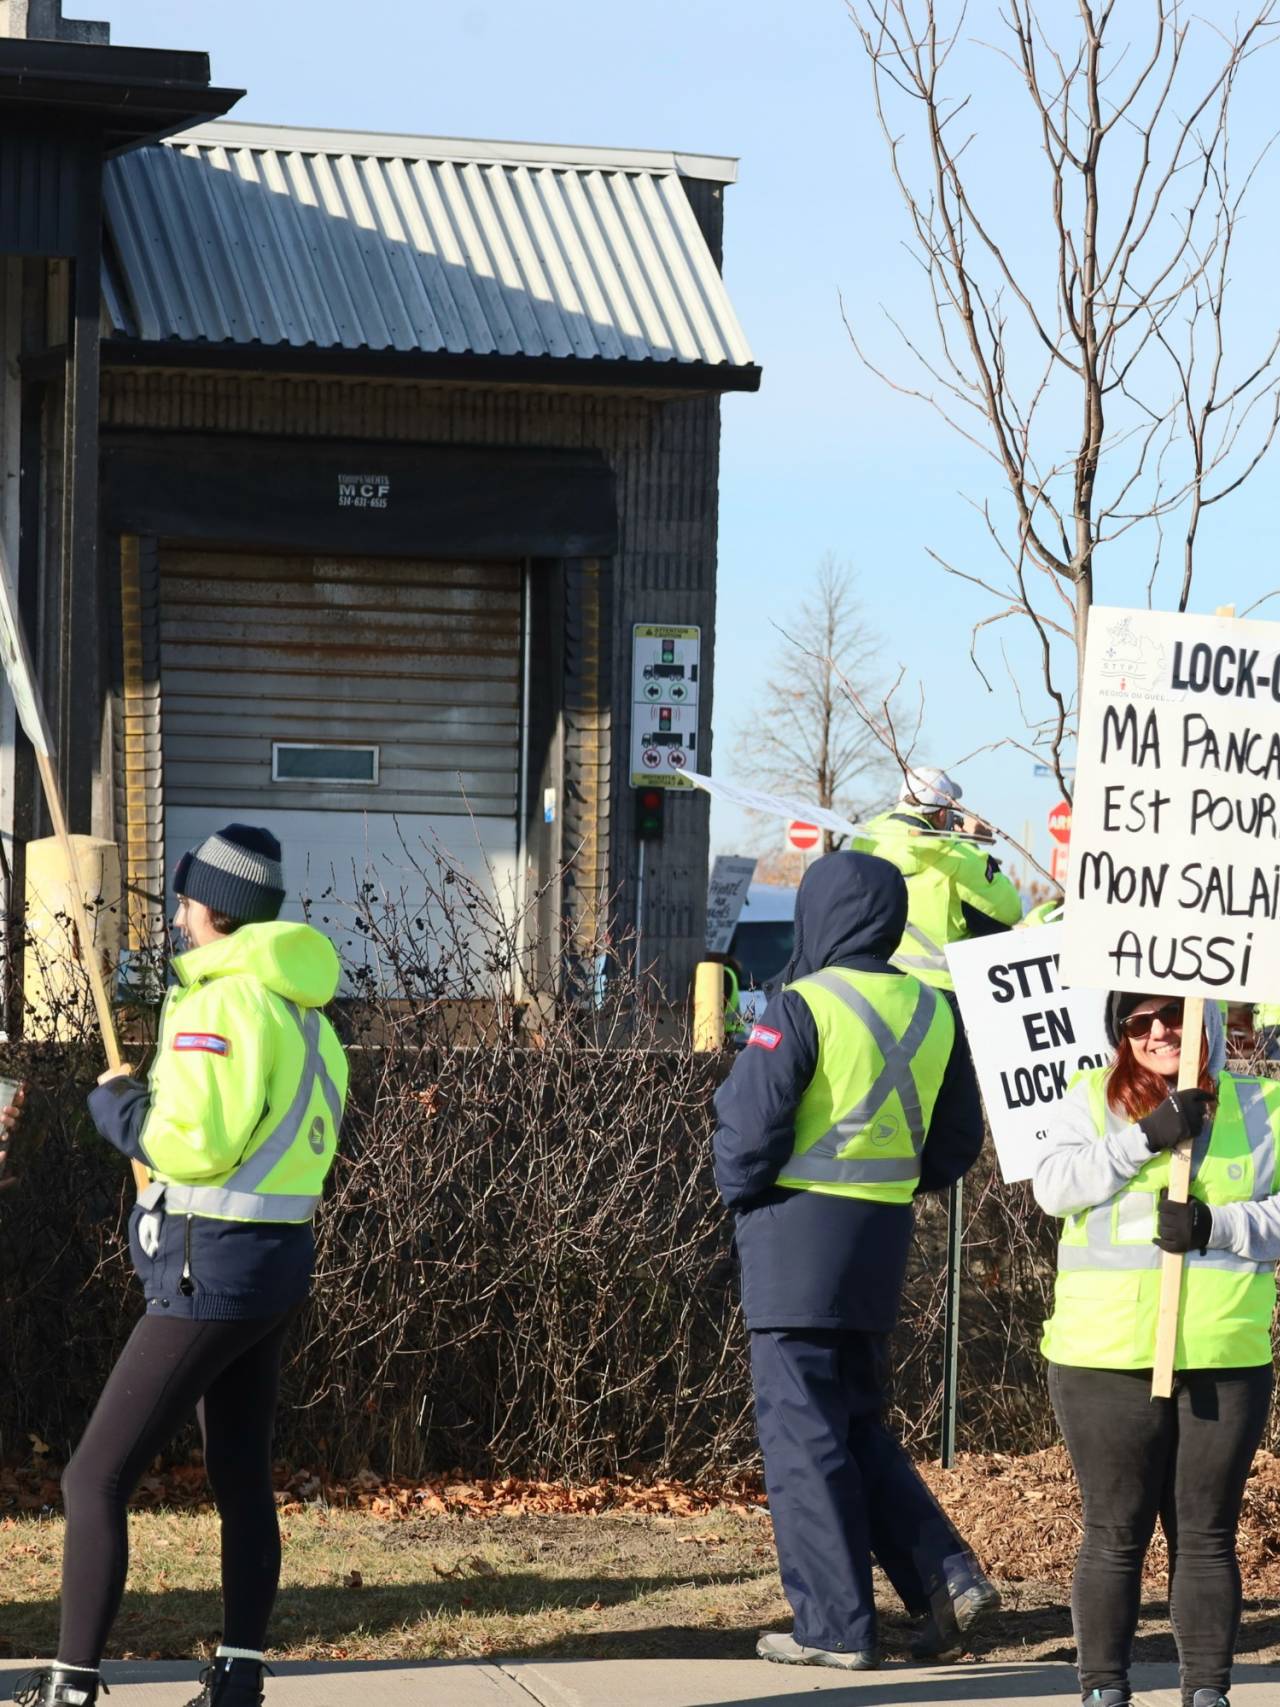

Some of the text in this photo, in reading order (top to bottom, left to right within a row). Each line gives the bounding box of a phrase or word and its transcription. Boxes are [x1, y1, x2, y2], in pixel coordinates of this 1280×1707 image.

[1101, 703, 1161, 769] MA
[1079, 851, 1170, 908] MON
[988, 953, 1070, 1003] STT
[1022, 1007, 1076, 1052] EN
